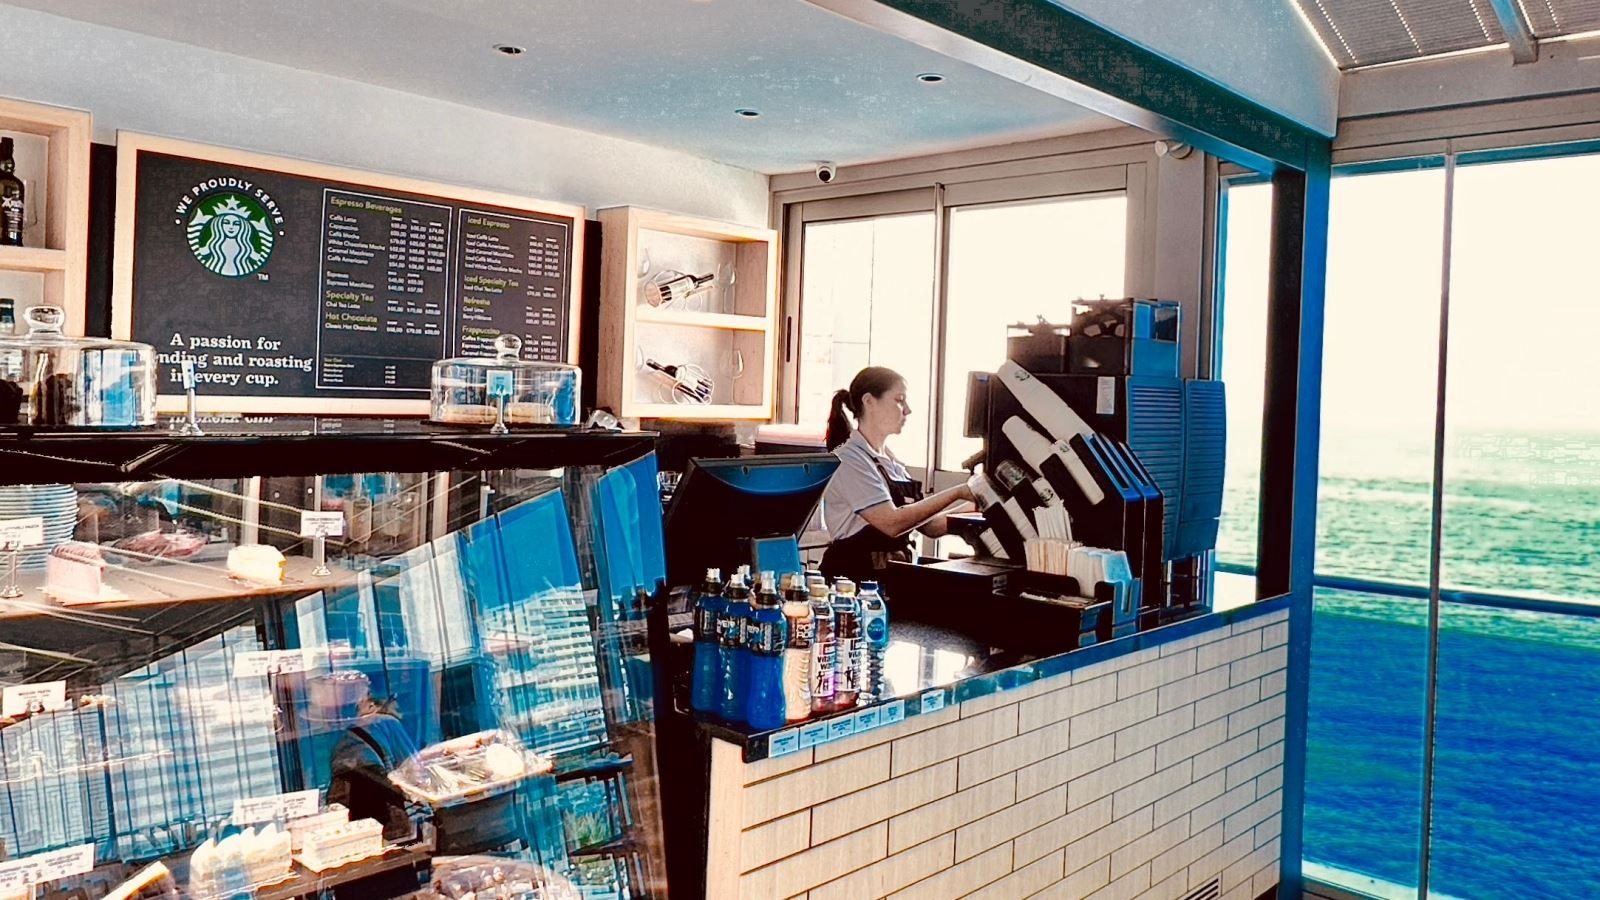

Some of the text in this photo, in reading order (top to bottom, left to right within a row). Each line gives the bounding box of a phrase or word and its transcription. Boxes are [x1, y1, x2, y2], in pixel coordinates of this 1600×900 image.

[176, 177, 284, 224] WE PROUDLY SERVE
[331, 196, 403, 214] Espresso Beverages
[467, 215, 511, 229] Iced Espresso
[257, 273, 269, 281] TM
[464, 275, 478, 283] Iced
[478, 276, 507, 288] Specialty
[326, 290, 374, 302] Specialty Tea
[325, 312, 378, 323] Hot Chocolate
[462, 325, 501, 337] Frappuccino
[170, 333, 281, 350] A passion for
[159, 351, 208, 368] nding
[213, 354, 243, 366] and
[249, 354, 313, 371] roasting
[194, 373, 240, 386] every
[246, 374, 279, 388] cup.
